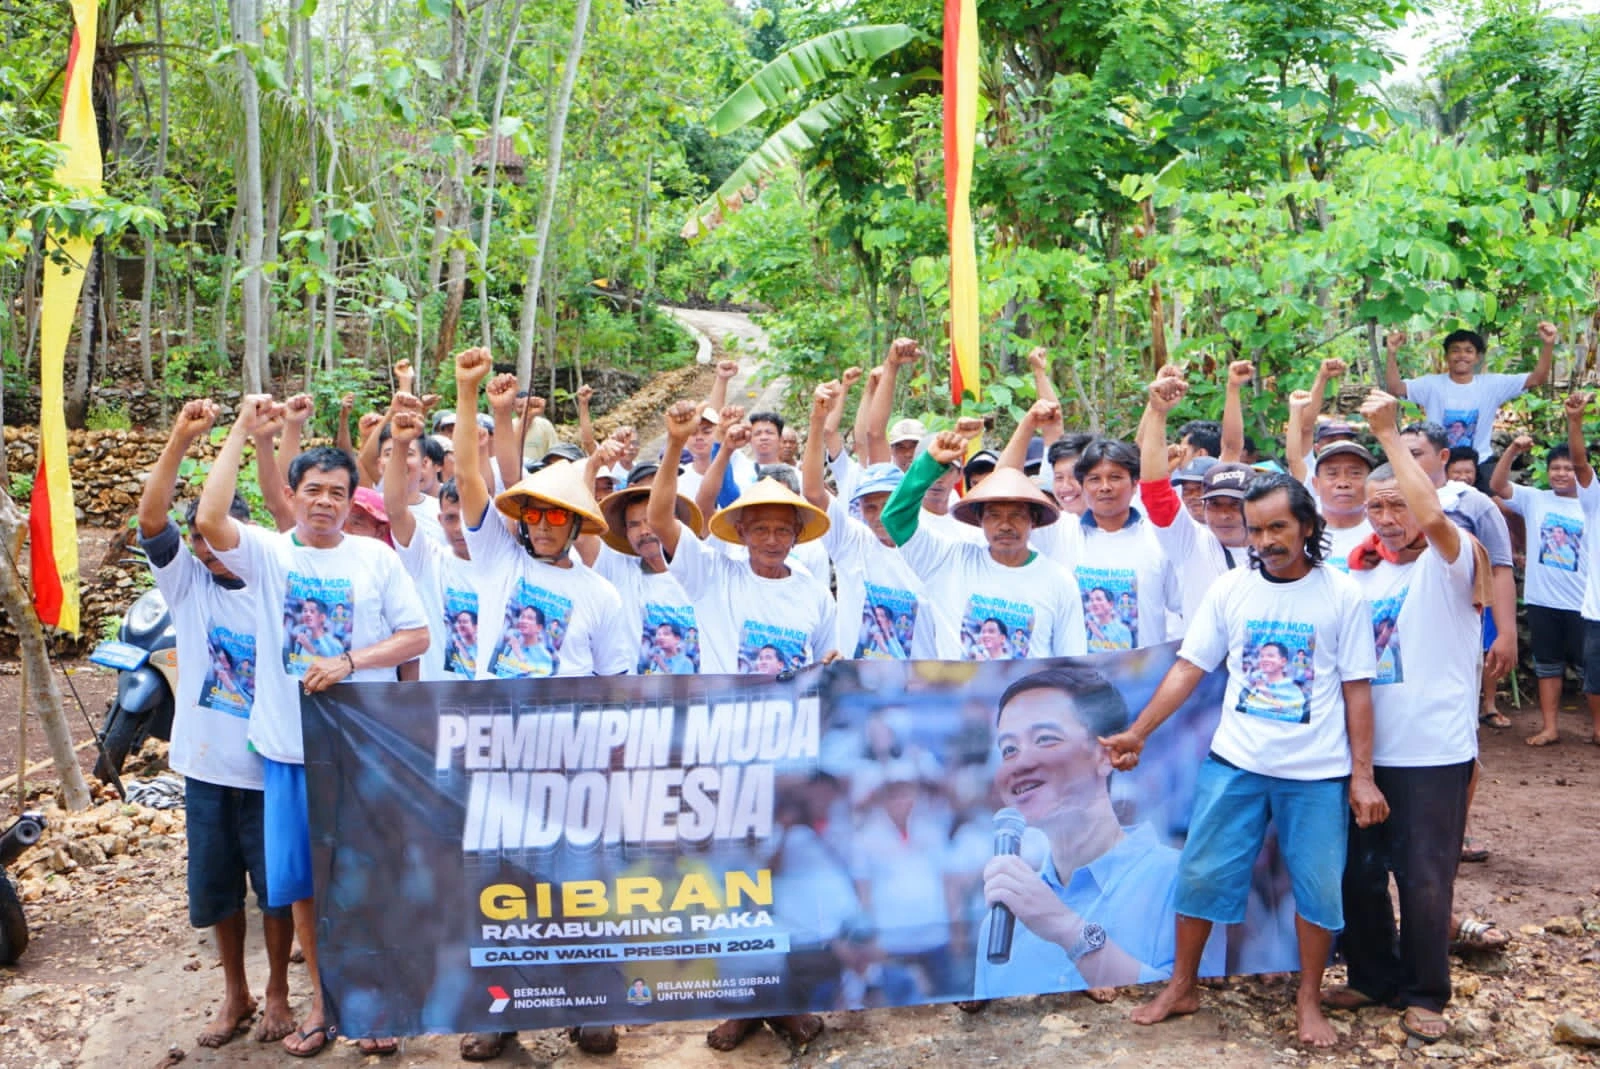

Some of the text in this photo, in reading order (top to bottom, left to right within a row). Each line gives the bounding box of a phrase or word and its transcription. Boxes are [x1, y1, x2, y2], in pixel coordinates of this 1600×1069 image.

[436, 696, 821, 770] PEMIMPIN MUDA
[463, 763, 775, 851] INDONESIA
[479, 869, 774, 921] GIBRAN
[481, 910, 774, 941] RAKABUMING RAKA
[485, 938, 776, 962] CALON WAKIL PRESIDEN 2024
[513, 986, 566, 998] BERSAMA
[656, 975, 780, 991] RELAWAN MAS GIBRAN
[656, 987, 756, 1001] UNTUK INDONESIA
[514, 995, 607, 1009] INDONESIA MAJU
